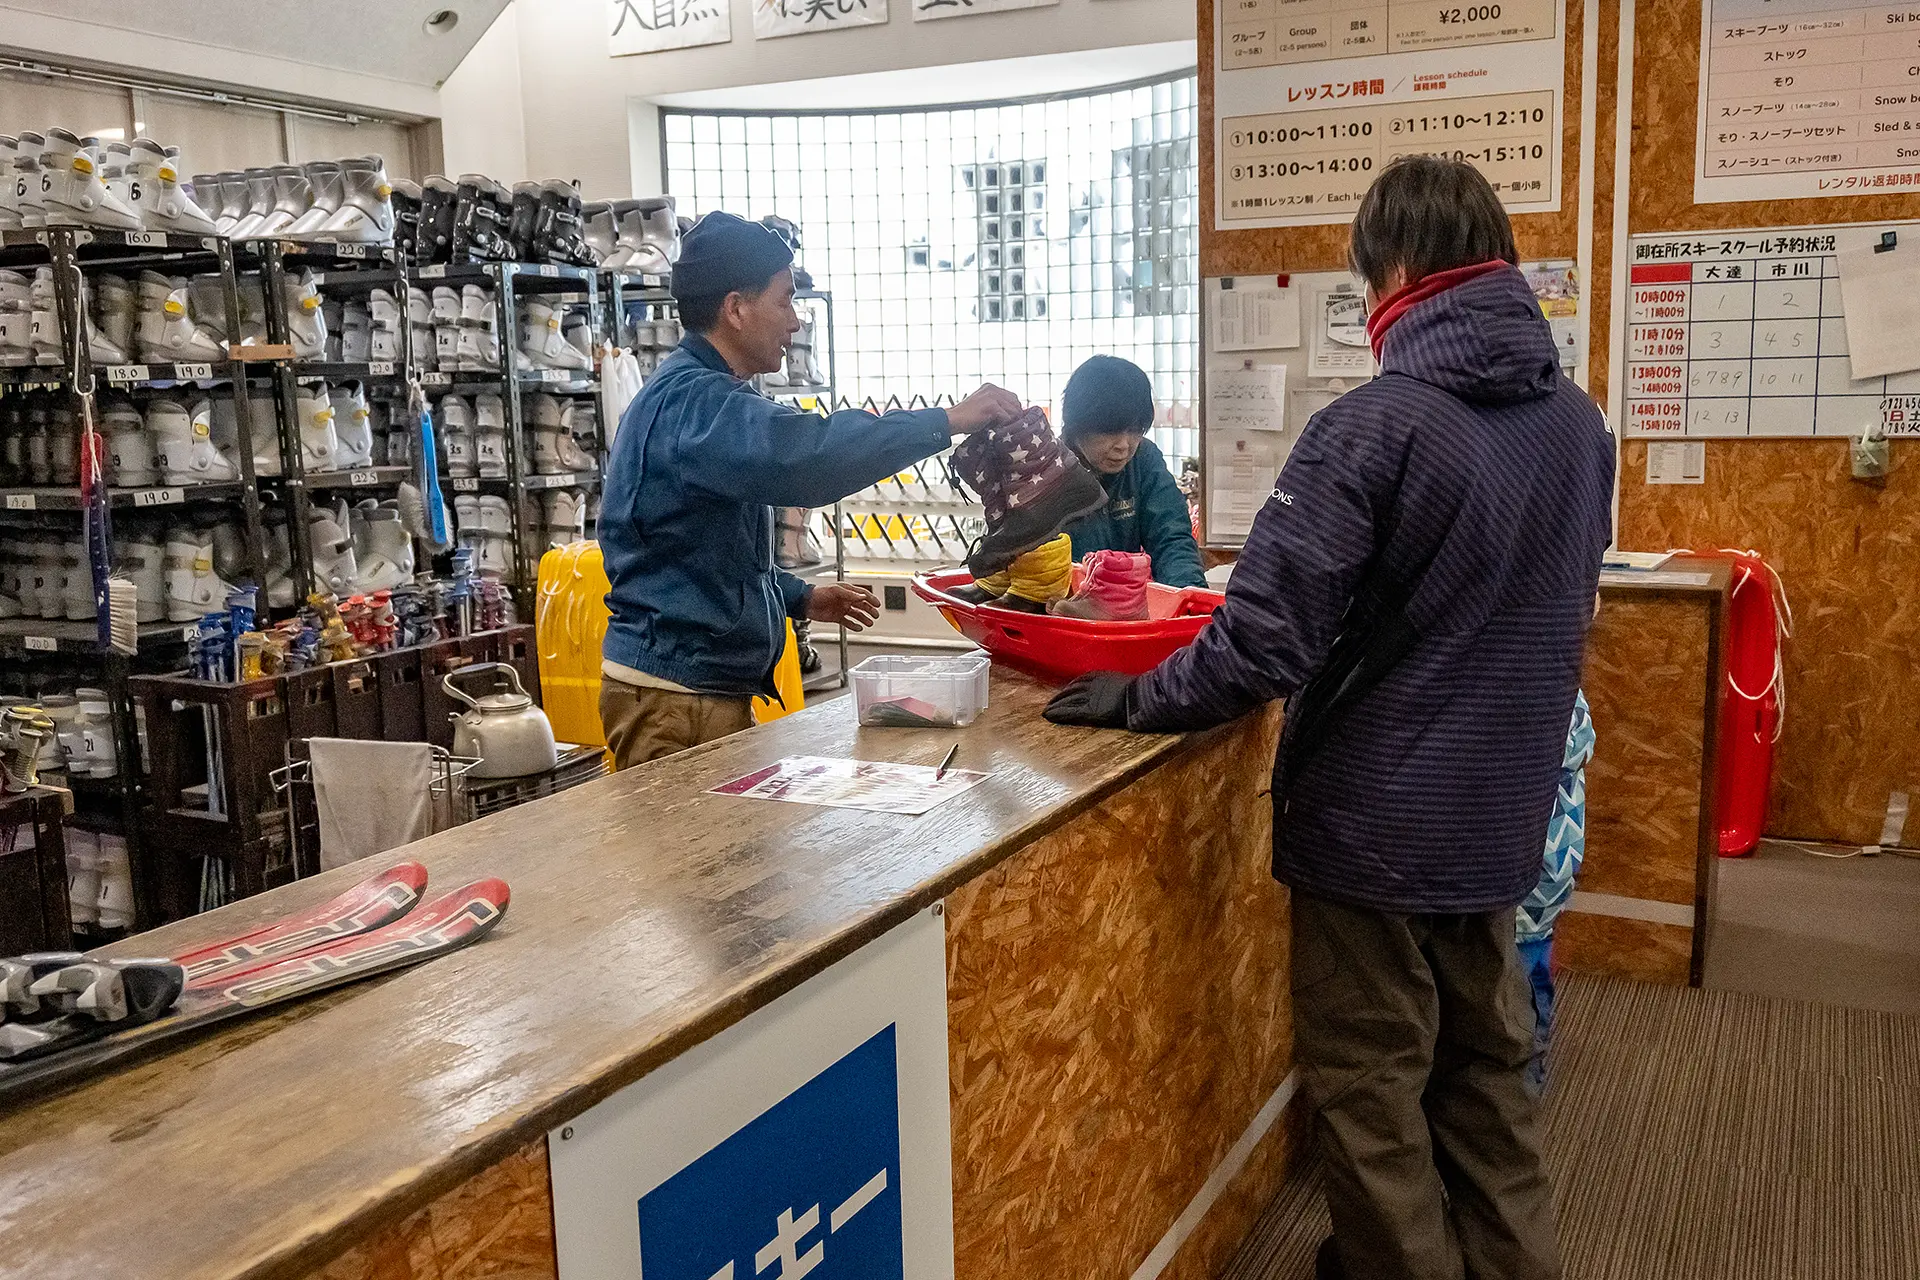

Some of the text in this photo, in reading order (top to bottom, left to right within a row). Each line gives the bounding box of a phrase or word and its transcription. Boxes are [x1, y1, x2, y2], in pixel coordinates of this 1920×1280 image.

[1439, 5, 1501, 24] ¥2,000
[1886, 13, 1904, 24] Ski
[1232, 31, 1266, 43] グループ
[1289, 27, 1317, 38] Group
[1725, 24, 1788, 39] スキーブーツ
[1764, 48, 1807, 62] ストック
[1413, 68, 1488, 82] Lesson schedule
[1774, 76, 1794, 87] そり
[1288, 79, 1384, 102] レッスン時間
[1874, 95, 1906, 105] Snow
[1721, 104, 1785, 117] スノーブーツ
[1874, 122, 1899, 132] Sled
[1903, 121, 1911, 130] &
[1718, 125, 1846, 143] そり・スノーブーツセット
[1896, 148, 1920, 158] Sno
[1718, 156, 1781, 169] スノーシュー
[42, 174, 52, 192] 6
[1328, 193, 1350, 202] Each
[128, 232, 151, 244] 16.0
[1636, 235, 1835, 260] 御在所スキースクール予約状況
[1634, 290, 1685, 303] 10時00分
[1782, 293, 1799, 307] 2
[1634, 328, 1684, 340] 11時10分
[1709, 331, 1723, 348] 3
[1764, 332, 1804, 347] 4 5
[114, 368, 138, 379] 18.0
[1631, 366, 1682, 379] 13時00分
[1631, 403, 1681, 416] 14時10分
[1694, 411, 1739, 425] 12 13
[144, 491, 169, 504] 19.0
